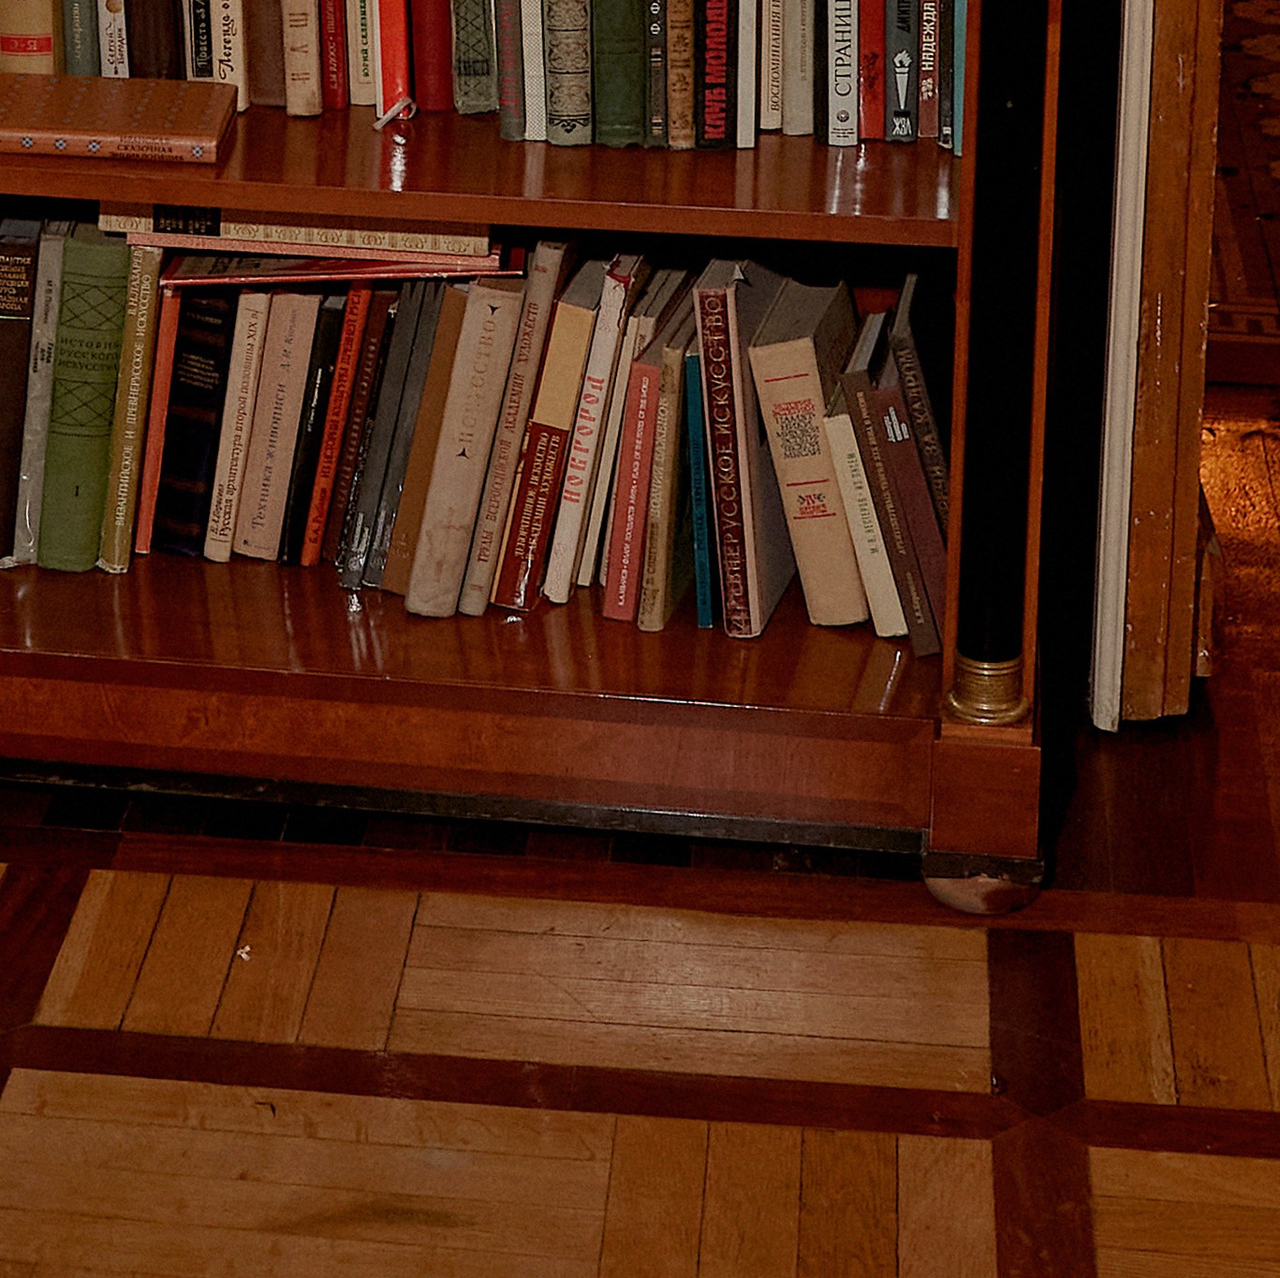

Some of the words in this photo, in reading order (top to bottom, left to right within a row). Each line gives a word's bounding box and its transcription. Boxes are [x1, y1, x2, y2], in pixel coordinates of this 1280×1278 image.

[921, 0, 936, 73] НАДЕЖДА
[704, 296, 732, 435] ИСКУССТВО
[116, 442, 133, 527] ВИЗАНТИЙСКОЕ
